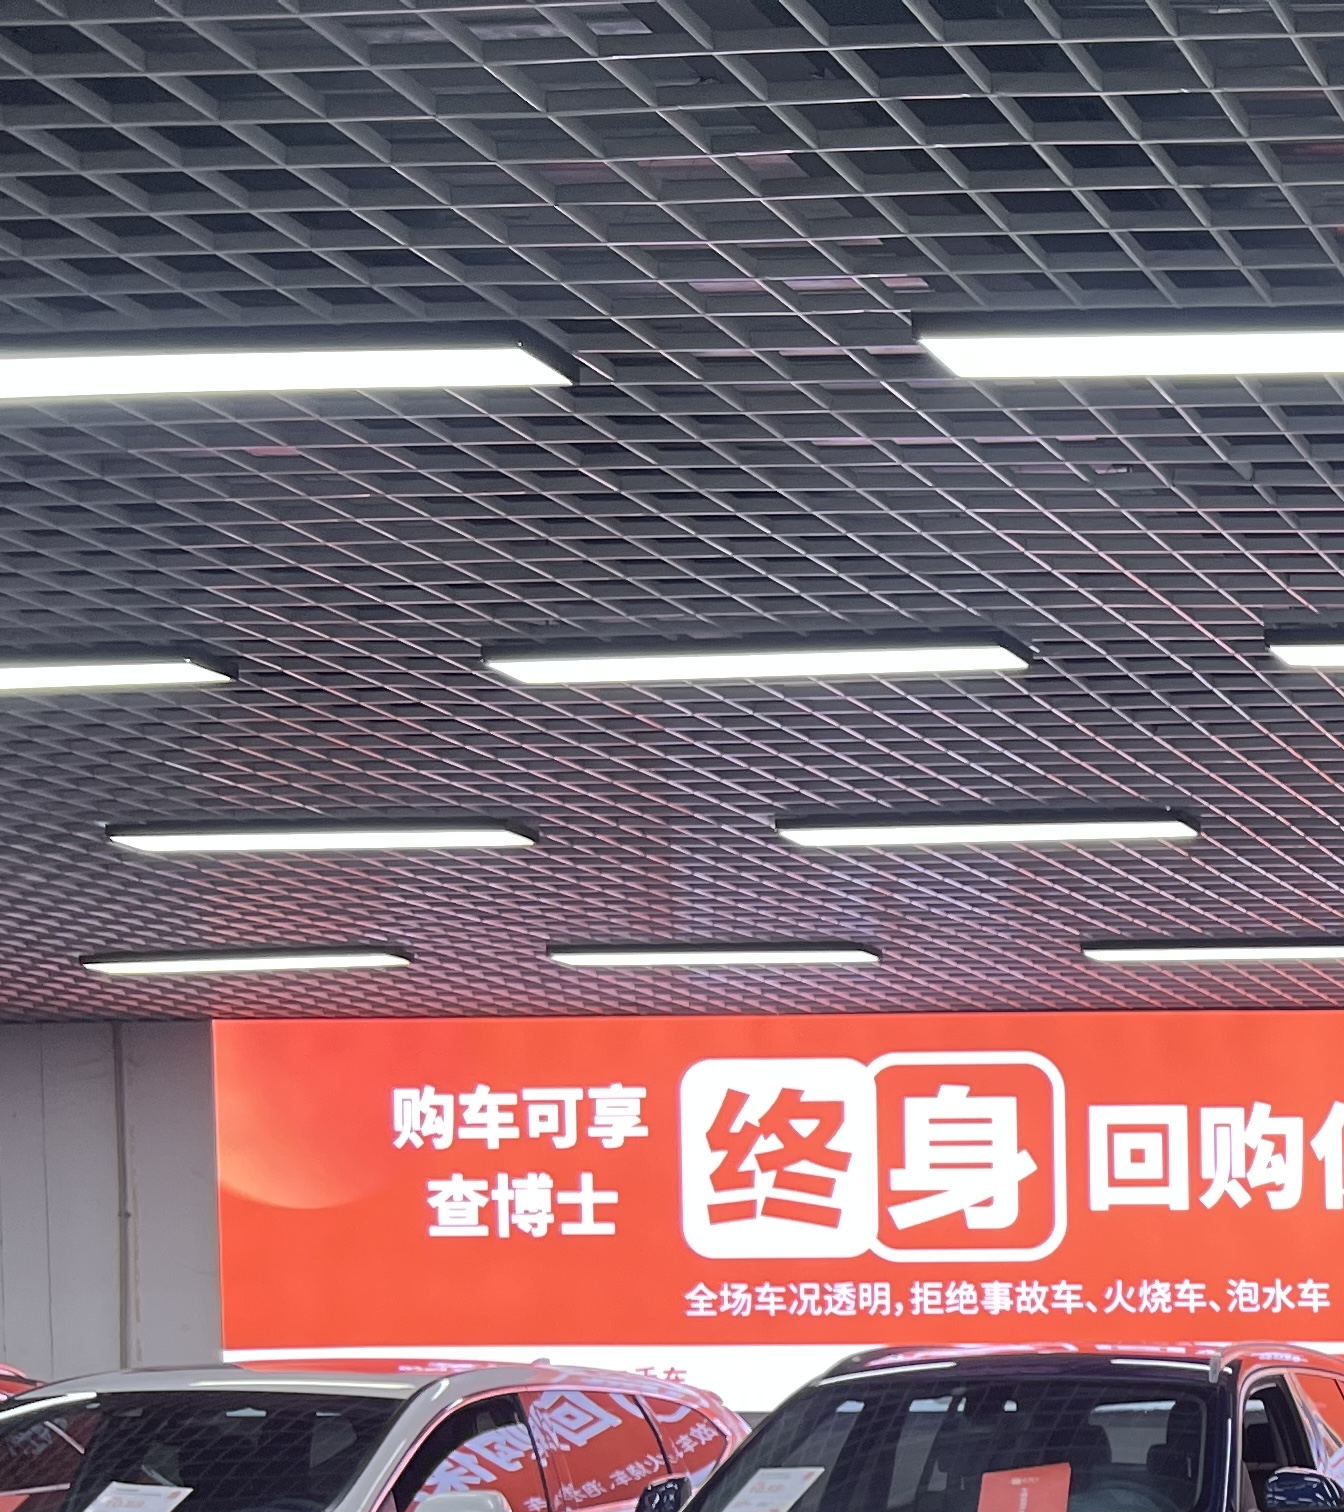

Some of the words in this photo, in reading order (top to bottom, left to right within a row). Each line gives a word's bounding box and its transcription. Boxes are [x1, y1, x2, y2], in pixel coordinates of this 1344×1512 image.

[392, 1082, 650, 1151] 购车可享
[426, 1172, 620, 1239] 查博士
